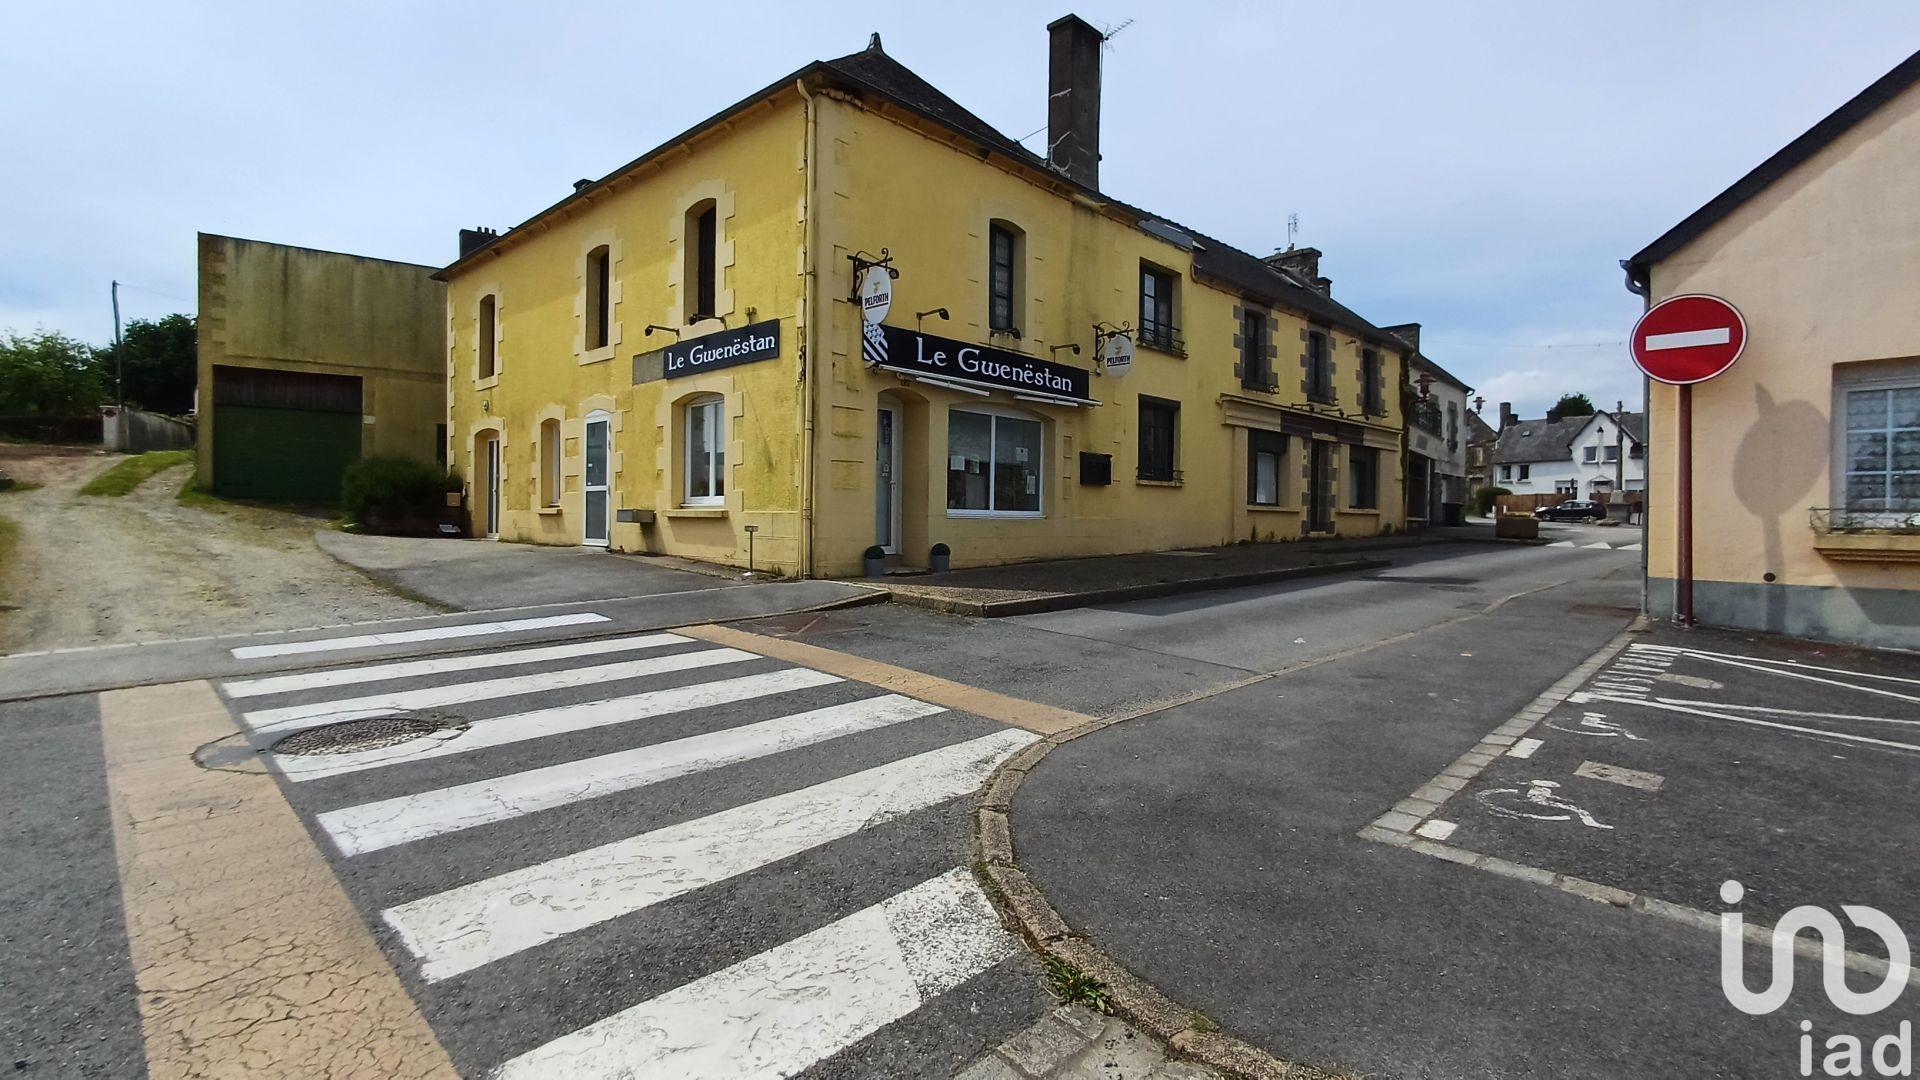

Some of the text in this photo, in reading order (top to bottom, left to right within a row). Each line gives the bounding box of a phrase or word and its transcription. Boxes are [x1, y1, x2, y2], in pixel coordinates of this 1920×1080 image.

[865, 293, 889, 306] PELFORTH
[668, 334, 775, 371] Le Gwenëstan
[916, 336, 1073, 392] Le Gwenëstan
